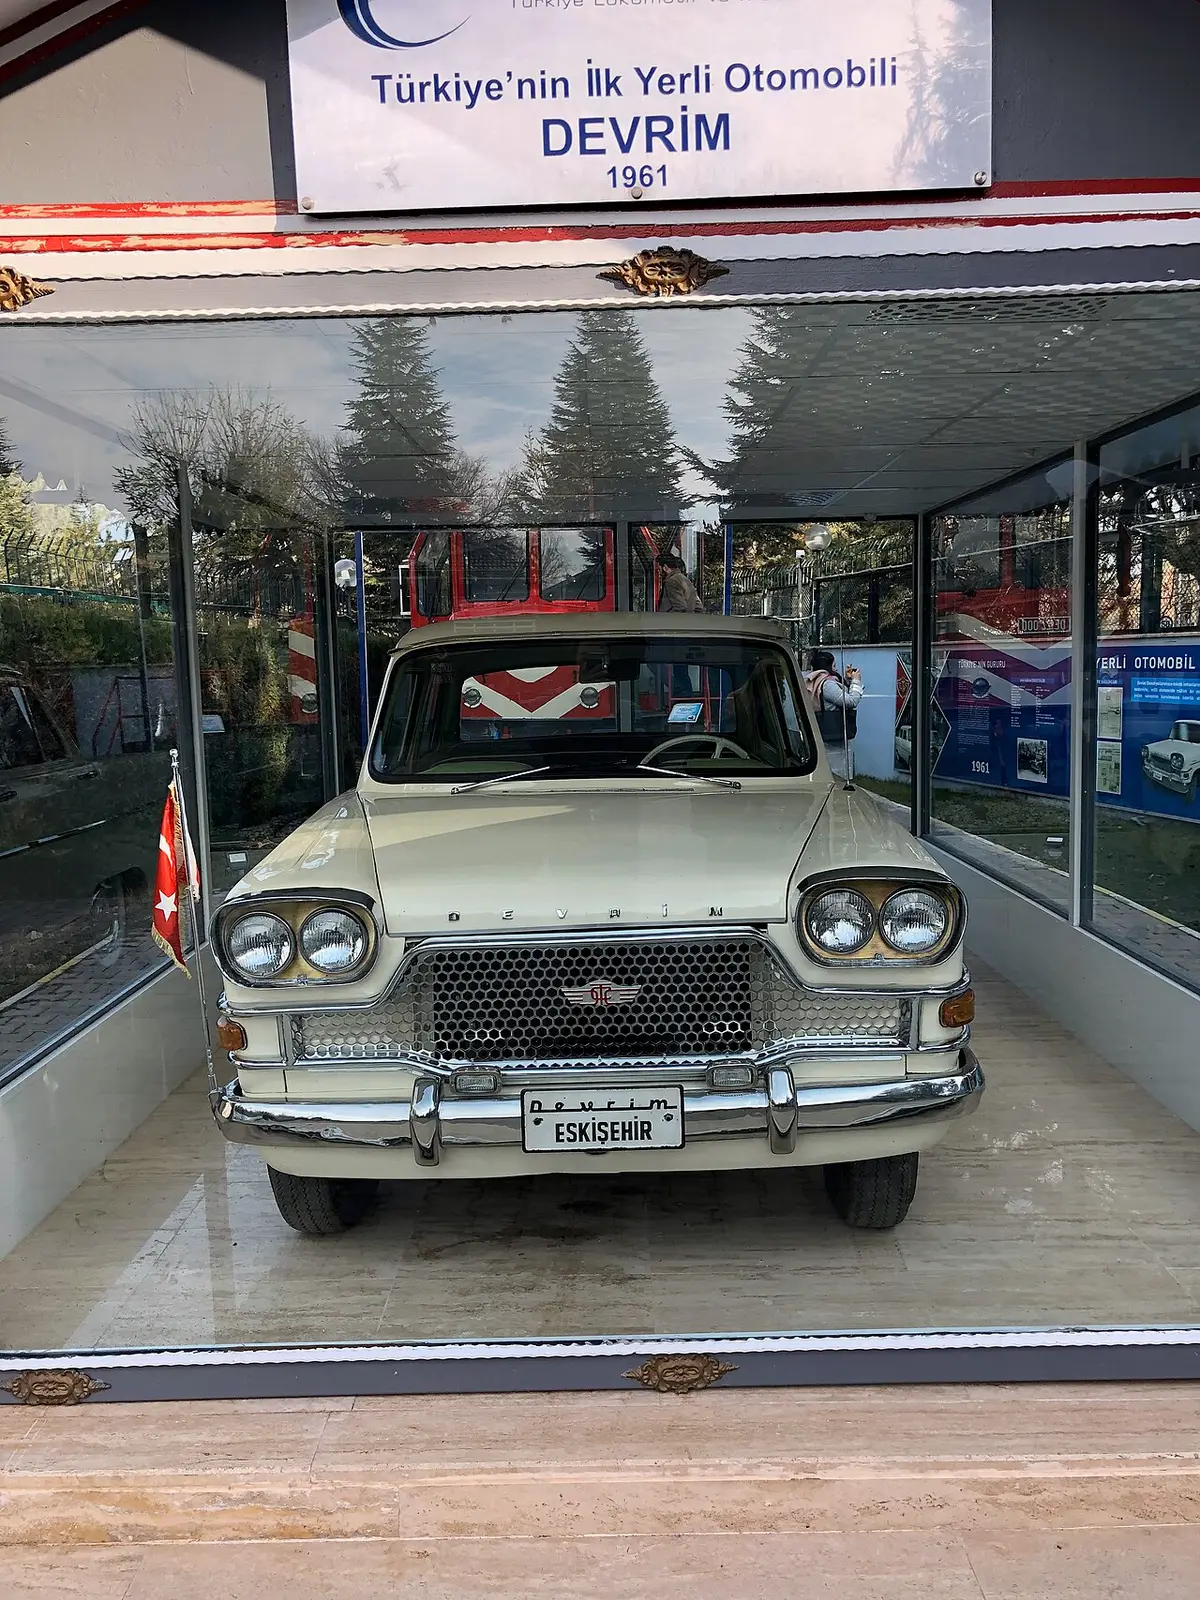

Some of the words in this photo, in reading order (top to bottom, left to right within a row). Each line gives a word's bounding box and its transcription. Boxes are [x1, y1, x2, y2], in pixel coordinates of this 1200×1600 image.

[371, 70, 570, 110] Türkiye’nin
[586, 58, 623, 97] İlk
[634, 63, 711, 96] Yerli
[724, 56, 898, 93] Otomobili
[542, 105, 730, 156] DEVRİM
[606, 164, 668, 188] 1961
[1134, 653, 1196, 669] OTOMOBİL
[971, 760, 990, 774] 1961
[555, 1116, 652, 1145] ESKİŞEHİR
